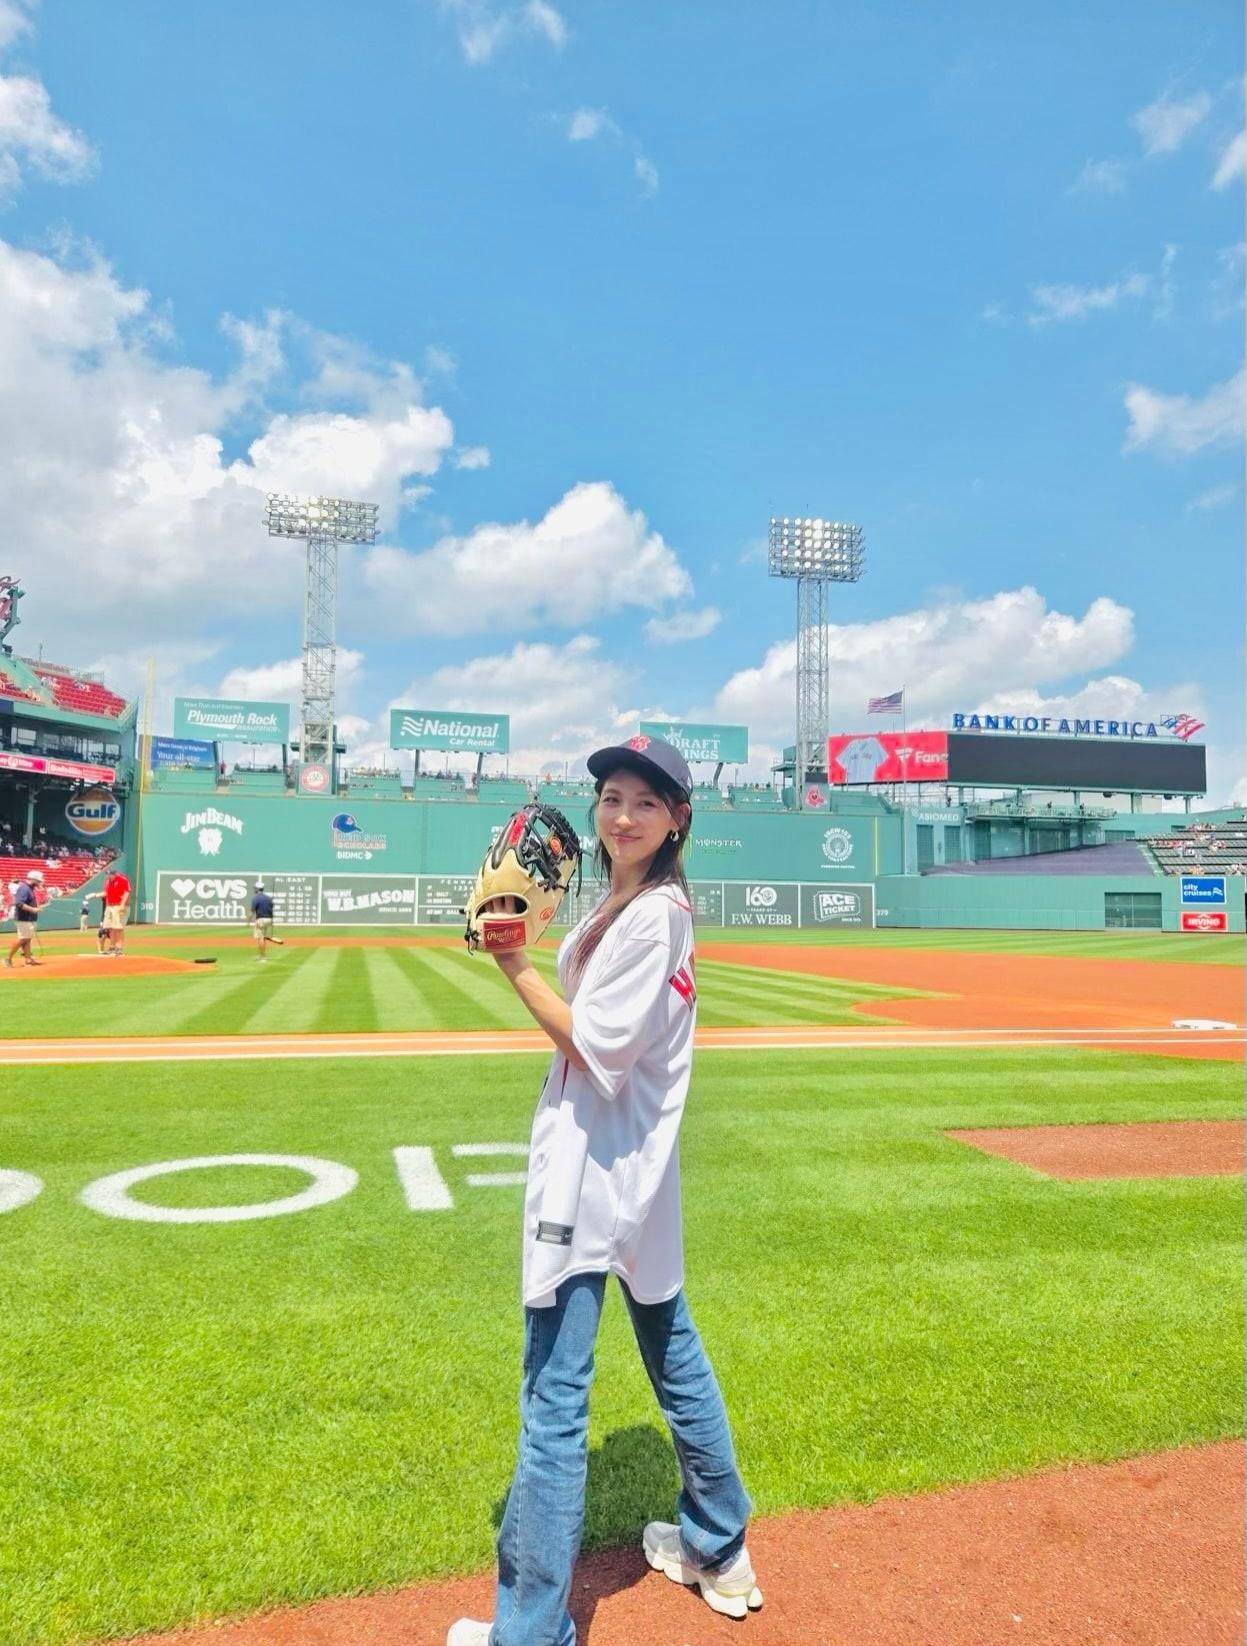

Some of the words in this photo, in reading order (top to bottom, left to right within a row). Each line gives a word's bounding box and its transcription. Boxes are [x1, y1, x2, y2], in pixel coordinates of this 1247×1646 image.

[187, 709, 244, 725] Plymouth
[247, 713, 277, 726] Rock
[954, 713, 1016, 731] BANK
[1024, 717, 1050, 731] OF
[1059, 719, 1158, 737] AMERICA
[424, 720, 499, 738] National
[680, 749, 719, 760] INGS
[67, 803, 117, 818] Gulf
[919, 813, 959, 822] ABIOMED
[337, 851, 364, 860] BIDMC
[196, 879, 247, 899] CVS
[745, 886, 778, 907] 160
[823, 893, 855, 906] ACE
[173, 900, 247, 919] Health
[823, 905, 855, 914] TICKET
[732, 914, 753, 925] F.W.
[757, 914, 792, 925] WEBB
